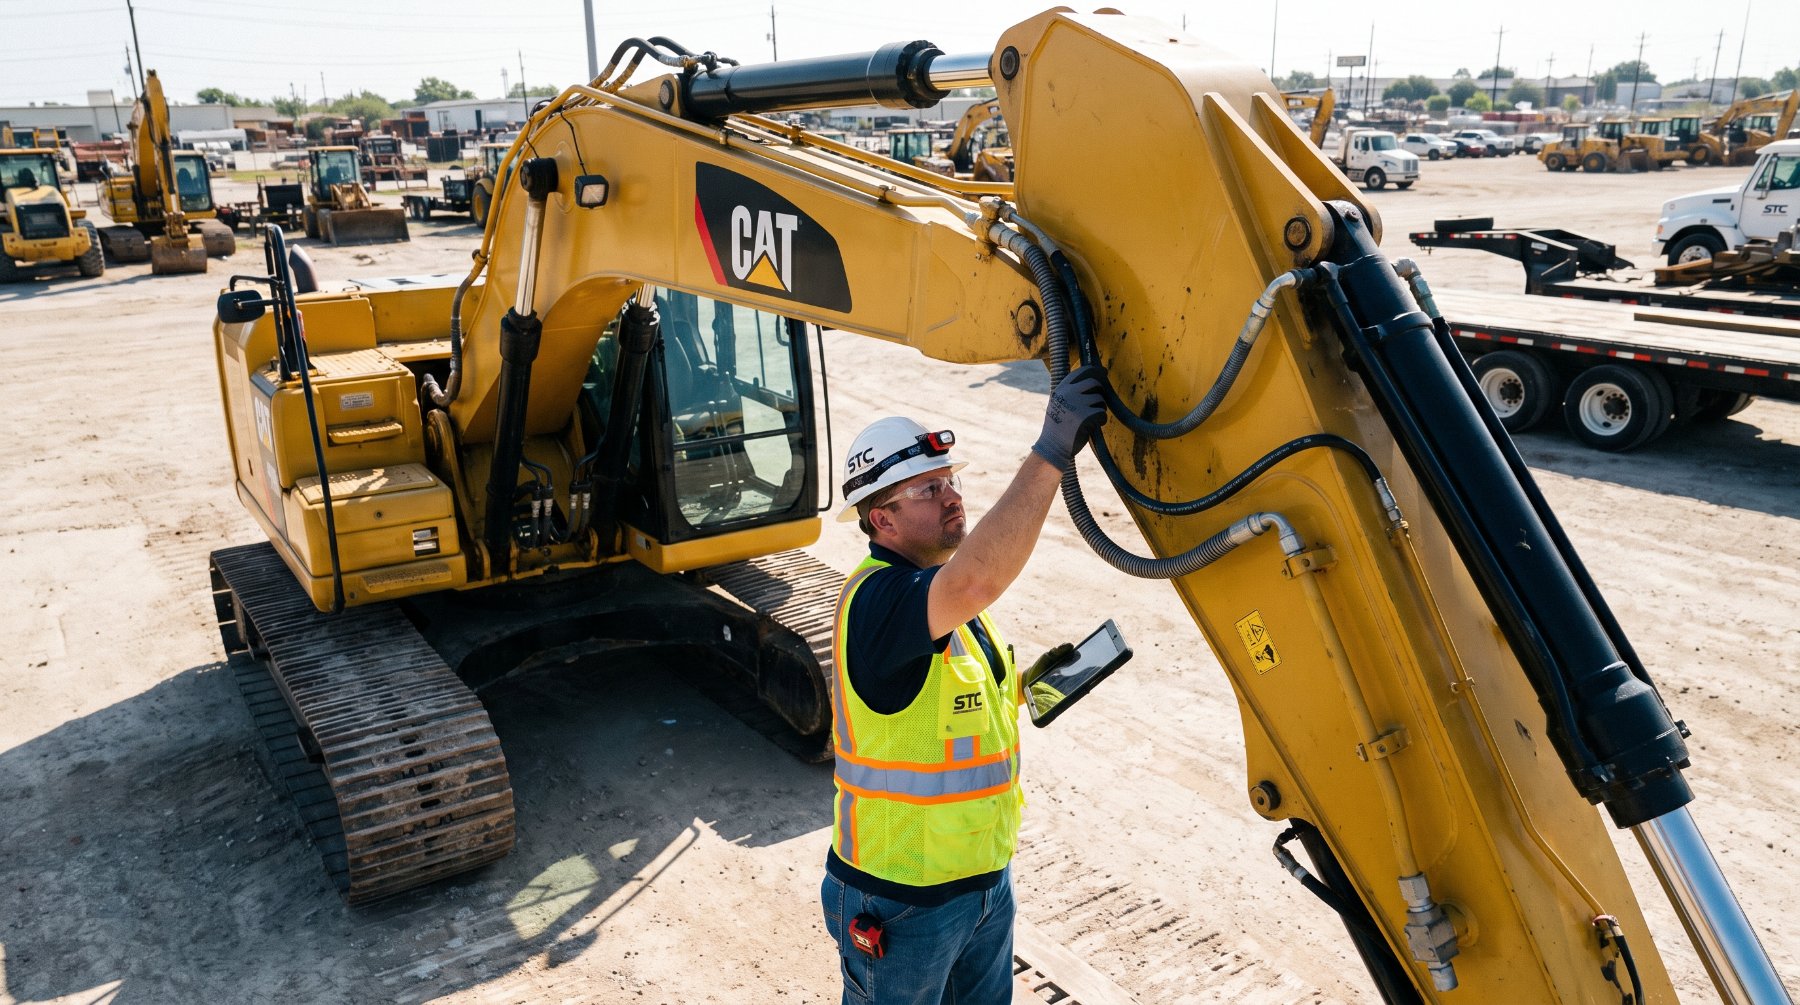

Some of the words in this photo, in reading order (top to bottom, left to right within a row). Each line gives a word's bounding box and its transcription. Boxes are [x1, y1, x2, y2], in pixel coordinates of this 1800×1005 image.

[1762, 204, 1789, 214] STC
[731, 205, 798, 292] CAT
[254, 396, 273, 453] CAT
[847, 446, 875, 475] STC
[953, 691, 983, 711] STC
